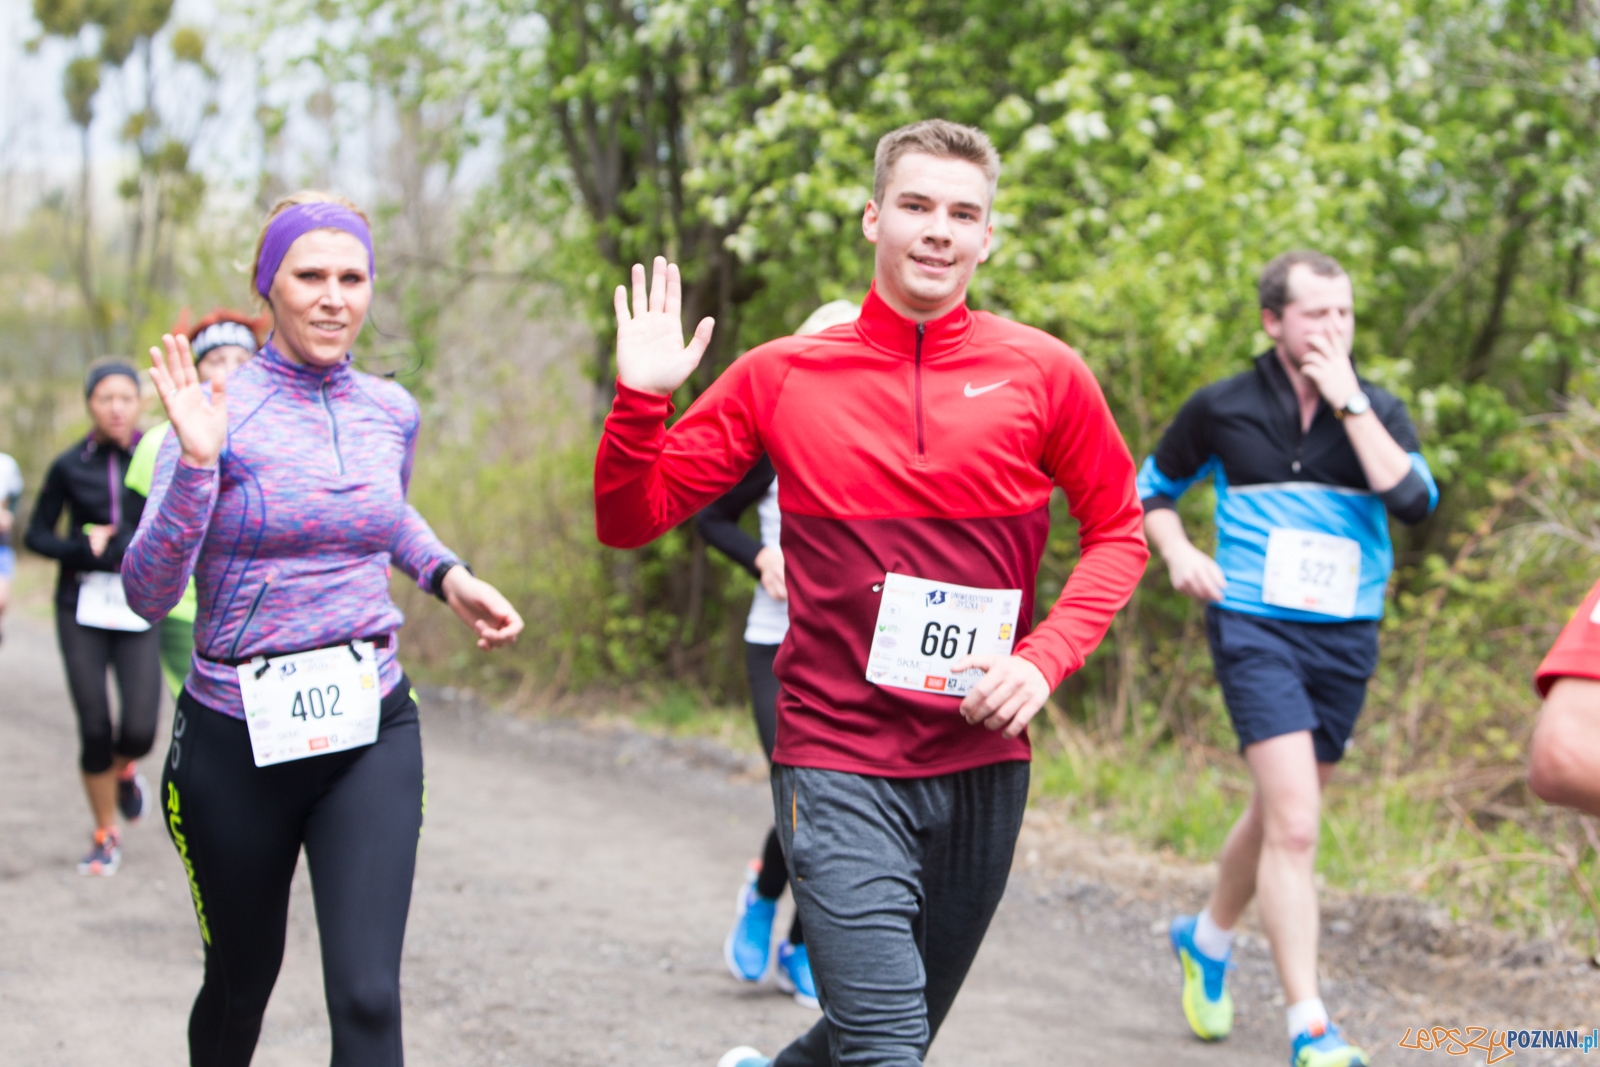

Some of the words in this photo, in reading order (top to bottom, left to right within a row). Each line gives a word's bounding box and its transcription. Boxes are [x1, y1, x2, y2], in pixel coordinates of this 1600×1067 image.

[920, 621, 978, 660] 661
[896, 657, 919, 670] 5KM
[291, 684, 343, 722] 402
